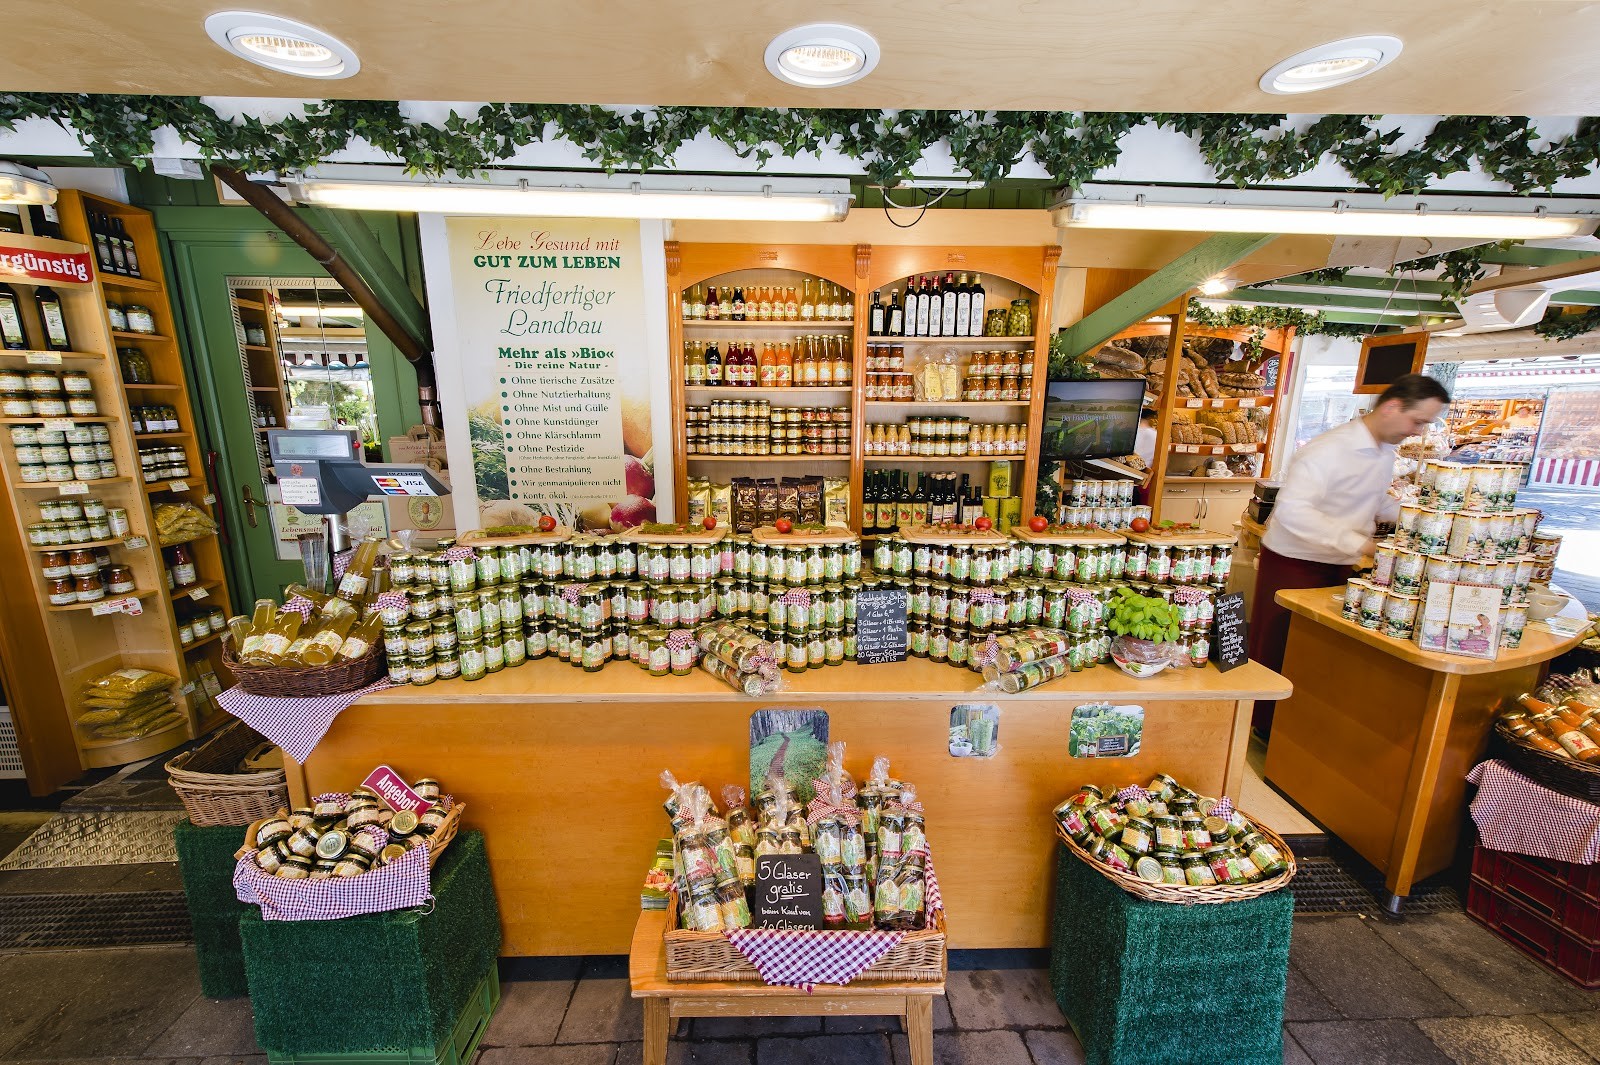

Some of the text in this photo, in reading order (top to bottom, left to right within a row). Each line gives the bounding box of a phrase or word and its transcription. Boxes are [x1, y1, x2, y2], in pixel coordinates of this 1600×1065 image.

[474, 230, 621, 251] Lebe Gesund mit
[473, 255, 621, 269] GUT ZUM LEBEN
[485, 278, 616, 311] Friedfertiger
[500, 309, 602, 336] Landbau
[498, 347, 540, 359] Mehr
[544, 347, 567, 359] als
[514, 361, 602, 369] Die reine Natur
[511, 375, 615, 385] Ohne tierische Zusätze
[512, 390, 611, 400] Ohne Nutztierhaltung
[514, 404, 609, 412] Ohne Mist und Gülle
[515, 417, 599, 428] Ohne Kunstdünger
[517, 431, 601, 440] Ohne Klärschlamm
[518, 444, 585, 453] Ohne Pestizide
[520, 465, 592, 475] Ohne Bestrahlung
[538, 479, 600, 488] genmanipulieren
[523, 492, 547, 500] Kontr.
[548, 491, 568, 500] ökol.
[869, 656, 897, 664] GRATIS
[376, 773, 421, 811] Angebot!
[757, 861, 812, 881] 5 Gläser
[766, 881, 804, 904] gratis
[761, 907, 780, 915] beim
[781, 905, 799, 915] Kauf
[776, 919, 815, 931] Gläsern
